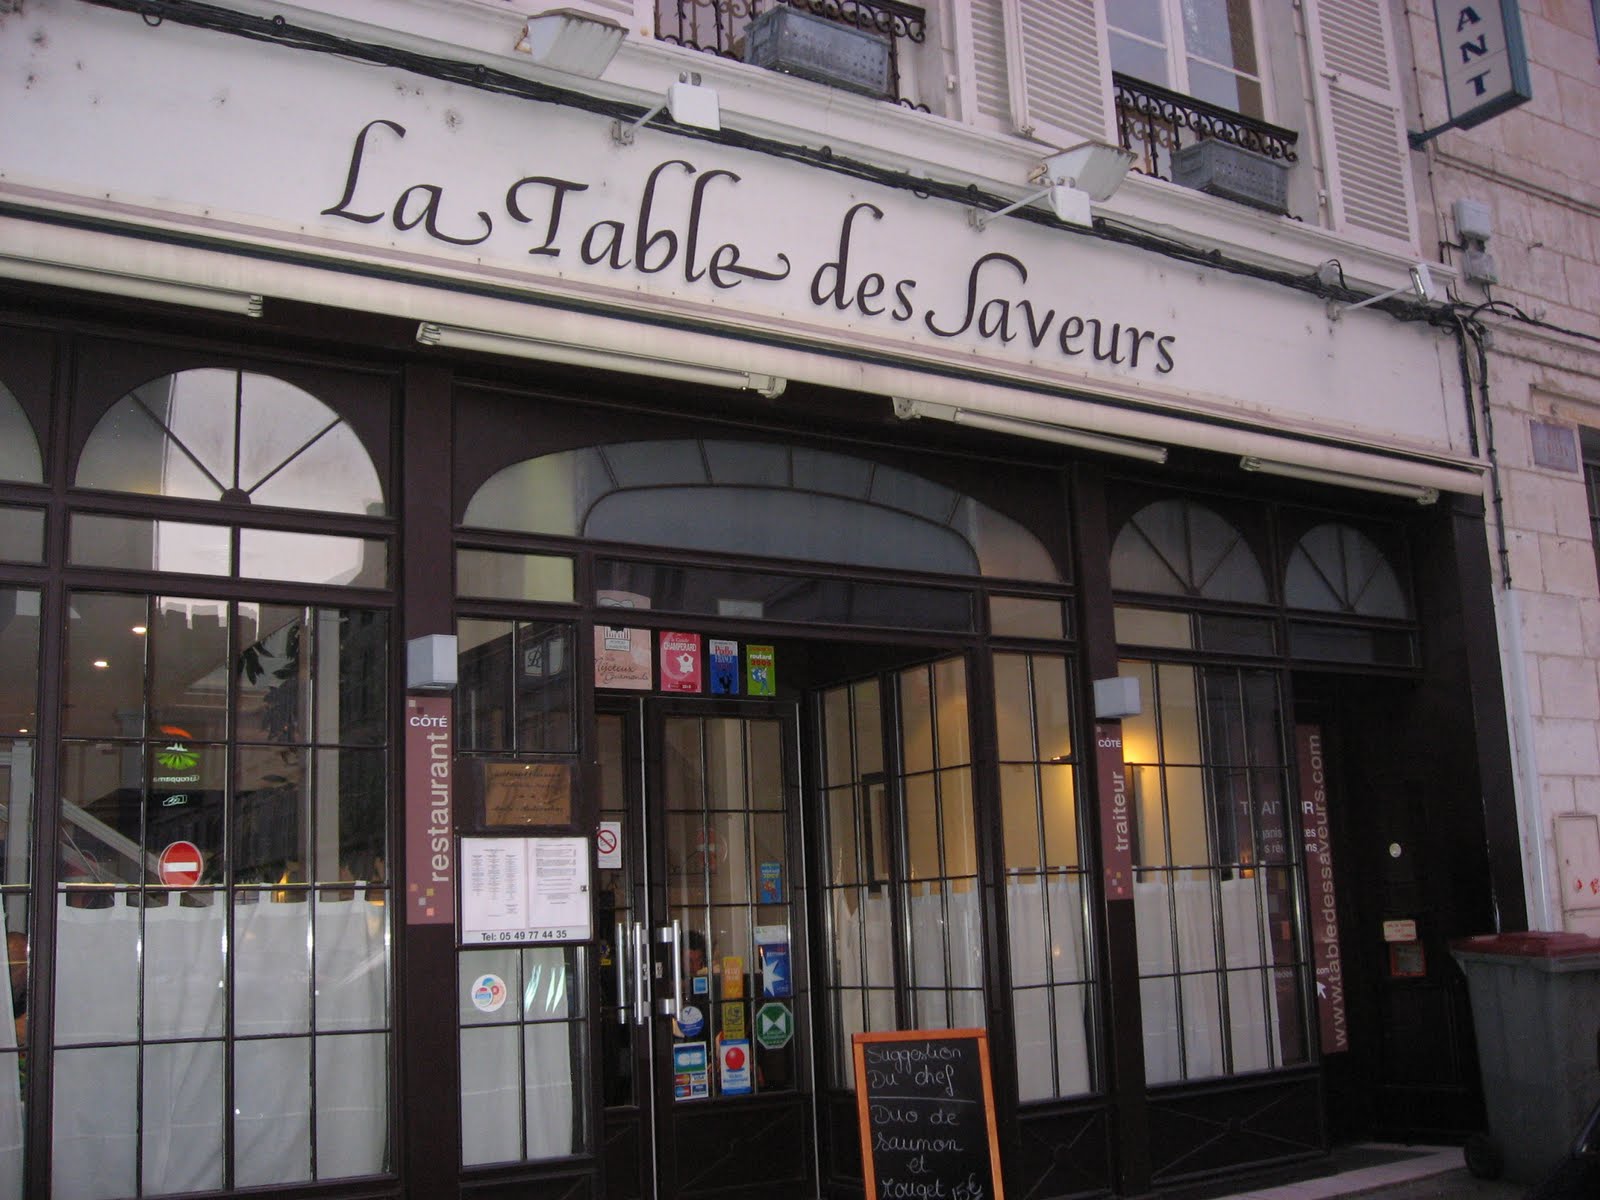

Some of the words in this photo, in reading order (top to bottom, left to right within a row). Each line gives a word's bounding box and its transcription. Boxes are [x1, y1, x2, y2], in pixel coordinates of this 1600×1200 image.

[321, 120, 492, 245] La
[506, 161, 790, 288] Table
[811, 203, 916, 321] des
[925, 253, 1175, 373] Saveurs
[410, 714, 448, 727] CÔTÉ
[427, 732, 449, 882] restaurant
[1112, 771, 1128, 852] traiteur
[1309, 735, 1346, 1047] www.tabledessaveurs.com
[481, 932, 497, 942] Tel:
[500, 932, 511, 941] 05
[514, 931, 525, 940] 49
[529, 931, 539, 940] 77
[542, 930, 553, 939] 44
[556, 930, 567, 938] 35
[867, 1043, 961, 1074] Suggestion
[868, 1070, 899, 1089] Du
[914, 1064, 954, 1096] chef
[870, 1104, 918, 1124] Duo
[930, 1108, 960, 1125] de
[907, 1154, 929, 1173] et
